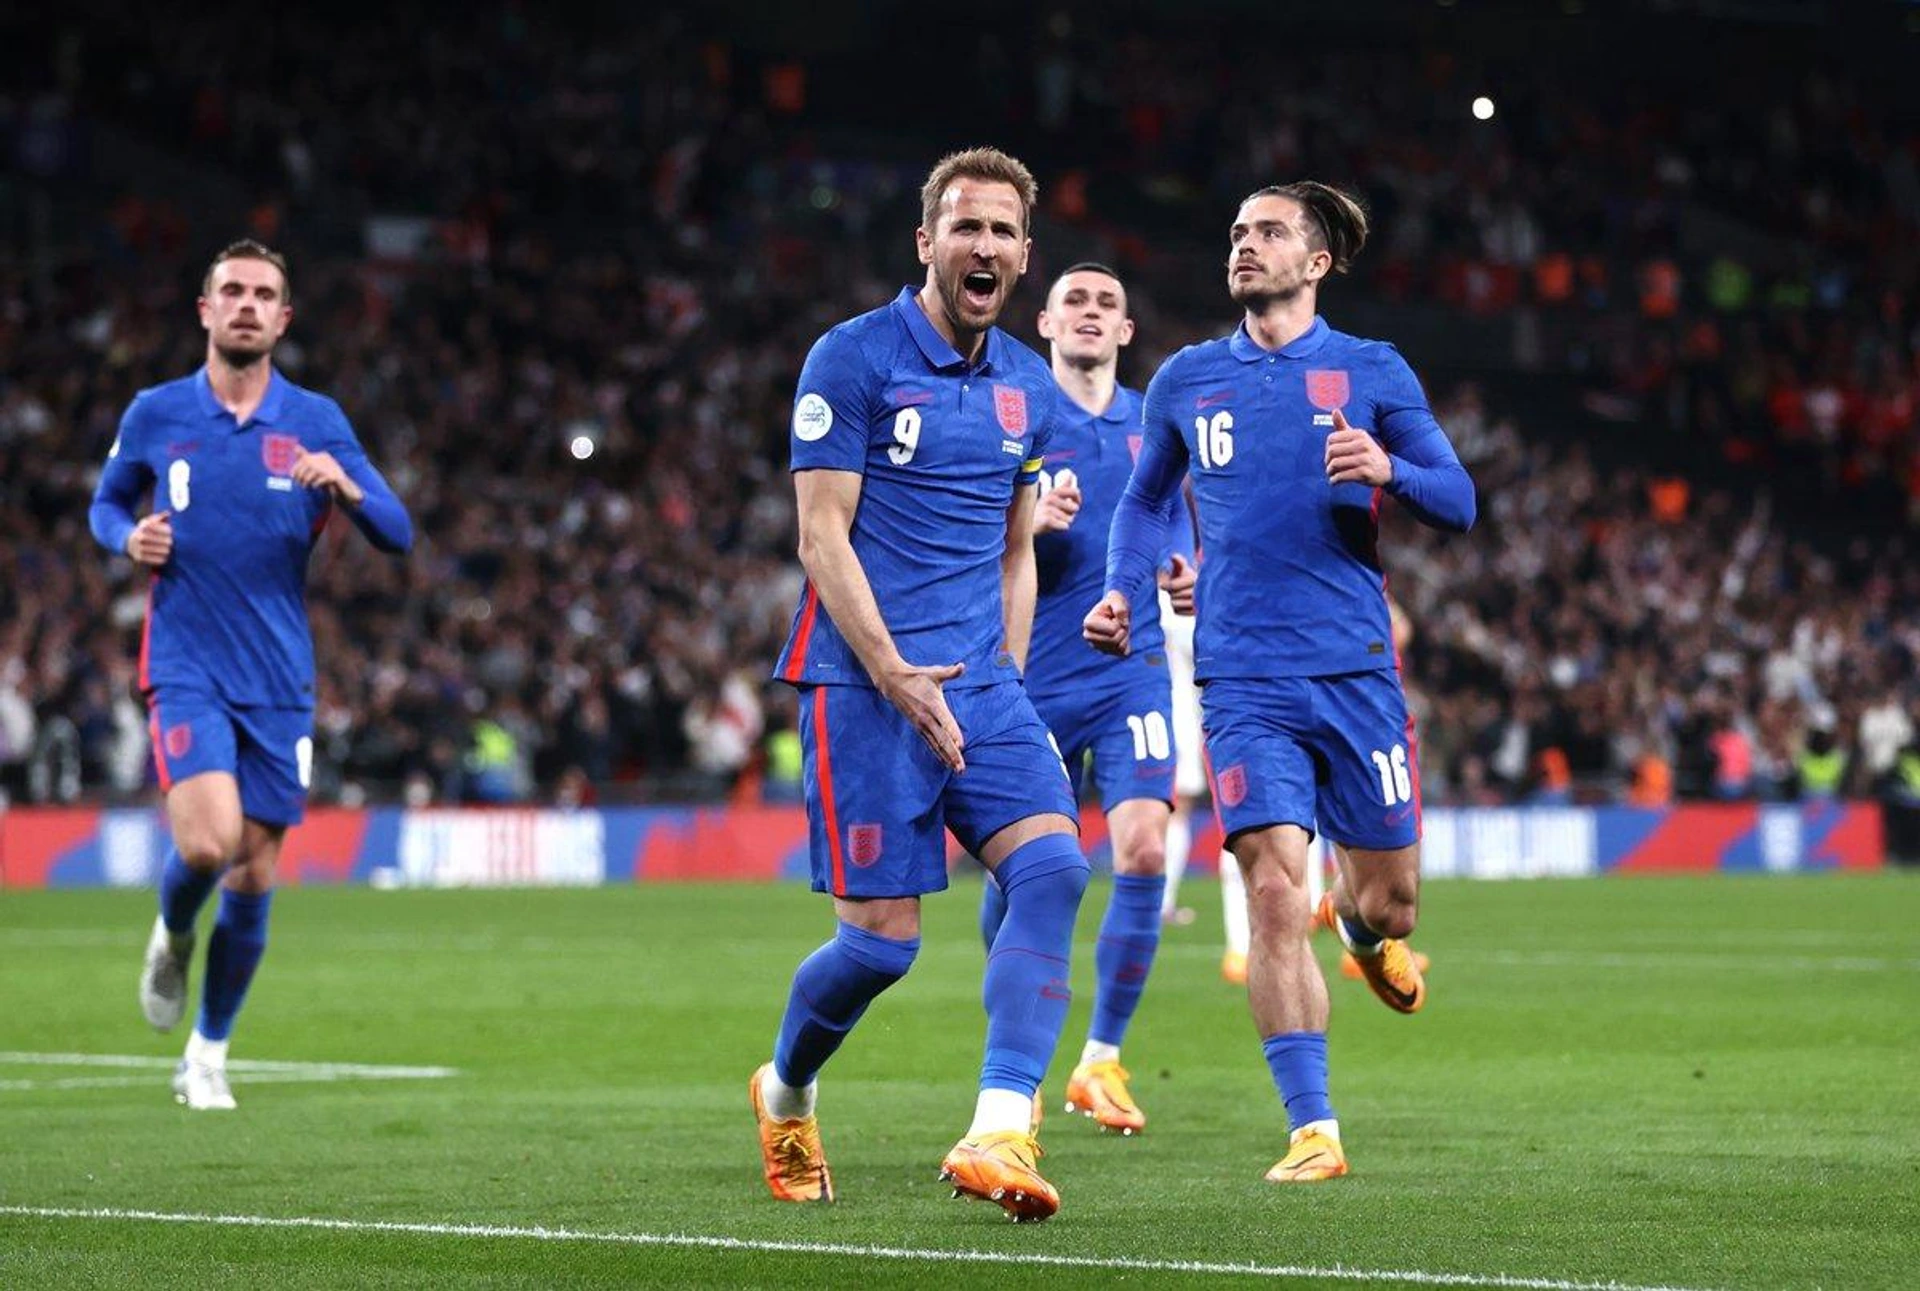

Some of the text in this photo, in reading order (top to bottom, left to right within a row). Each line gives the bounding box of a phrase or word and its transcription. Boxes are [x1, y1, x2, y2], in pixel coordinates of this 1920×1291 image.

[887, 407, 922, 466] 9
[1195, 410, 1233, 469] 16
[168, 458, 190, 513] 8
[1126, 711, 1170, 761] 10
[1371, 744, 1411, 806] 16
